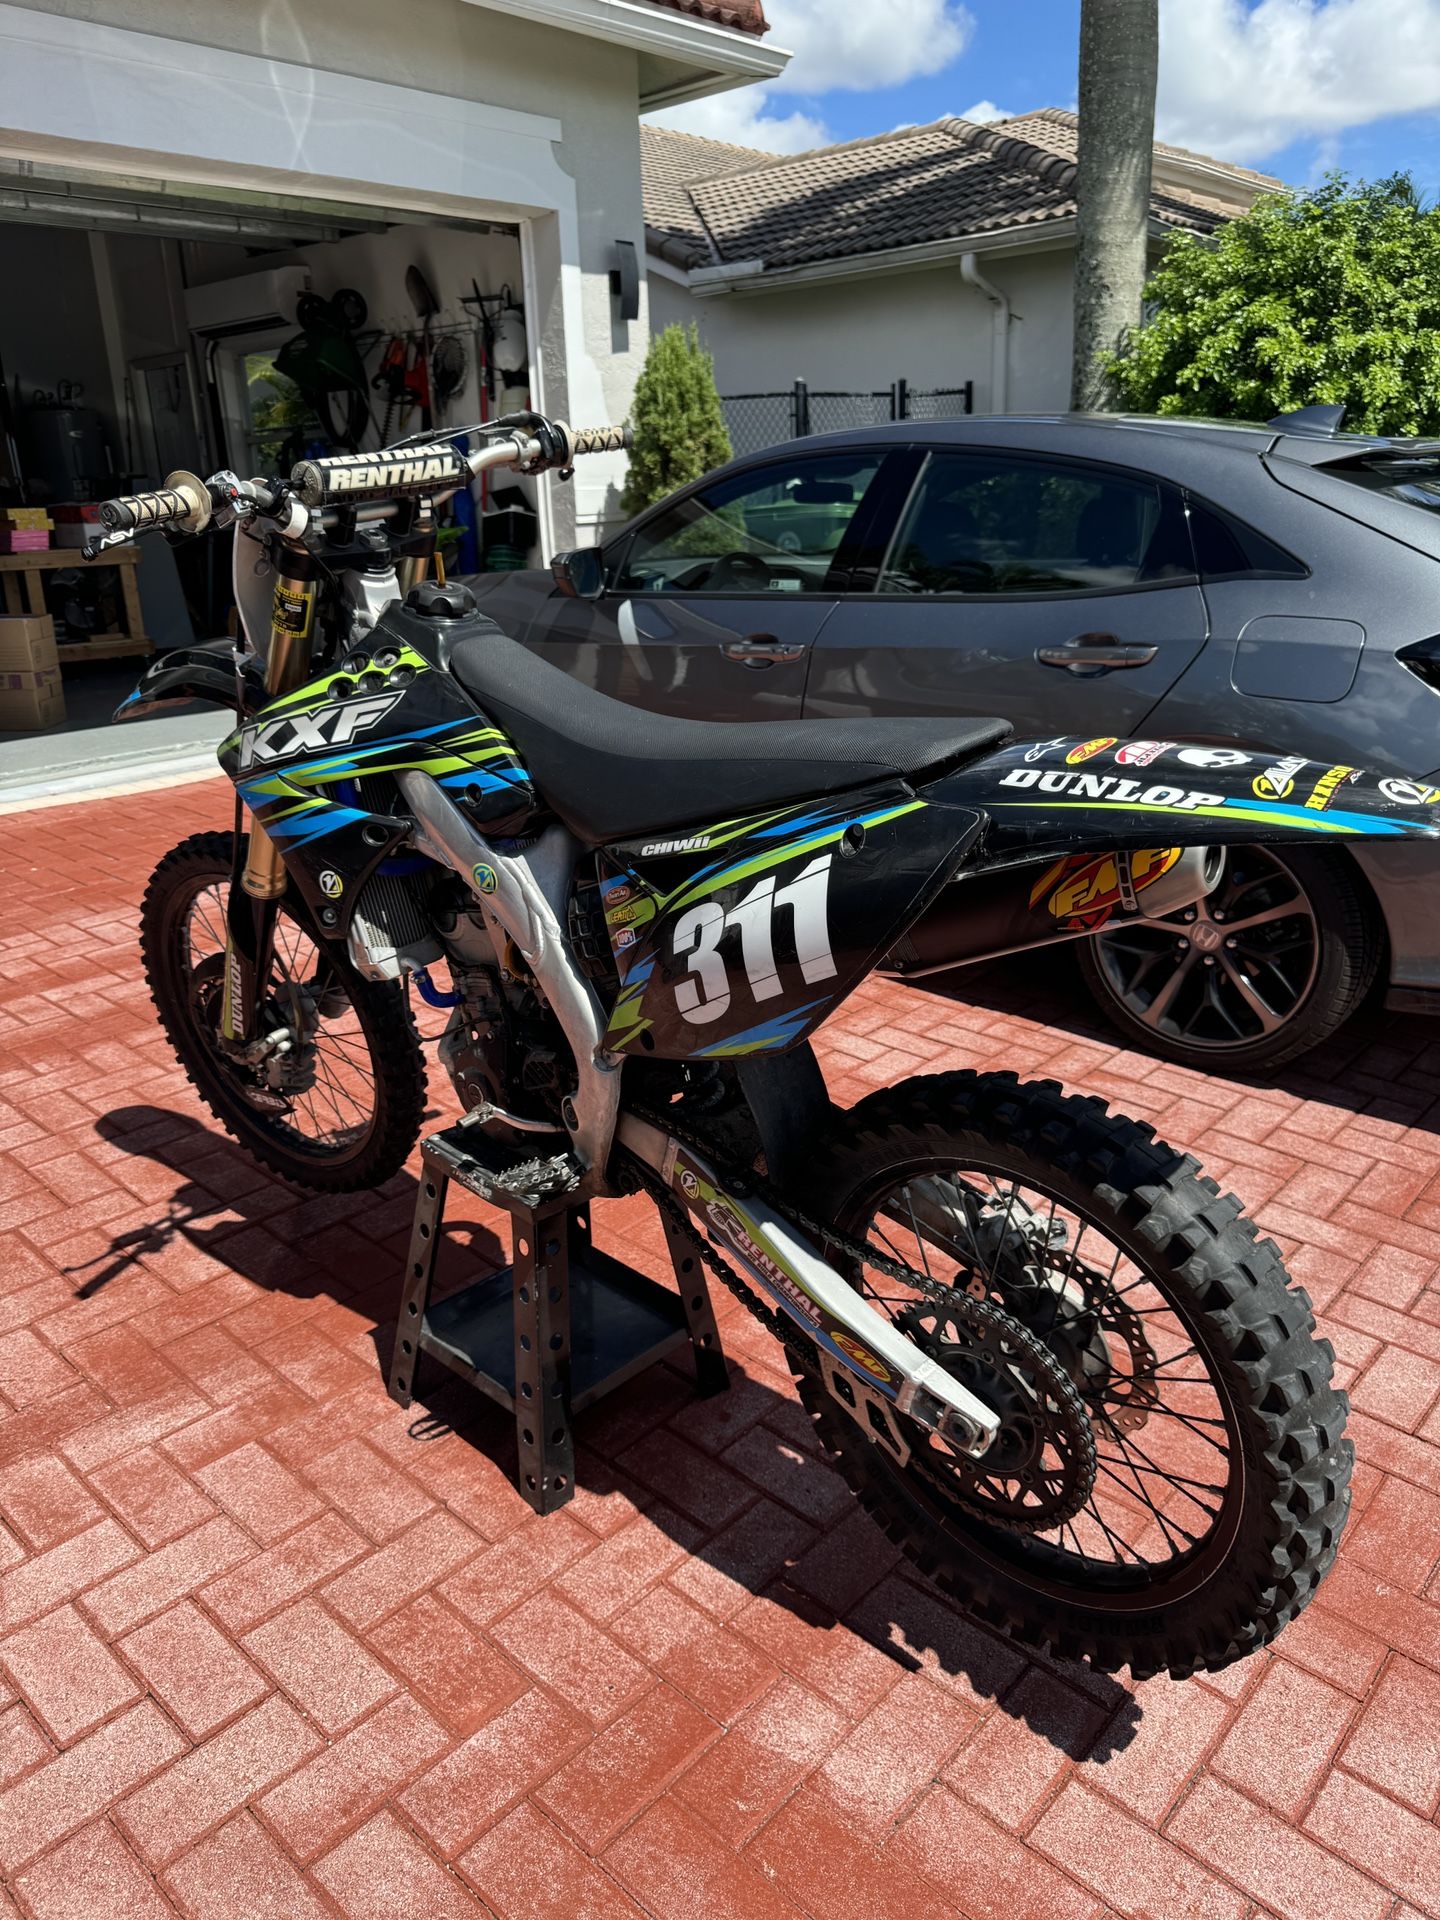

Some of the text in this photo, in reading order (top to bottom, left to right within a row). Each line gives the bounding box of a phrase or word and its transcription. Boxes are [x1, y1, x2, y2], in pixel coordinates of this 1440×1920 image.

[328, 456, 460, 491] RENTHAL
[100, 527, 134, 550] ASV
[238, 692, 403, 771] KXF
[1067, 738, 1112, 763] FMF
[998, 768, 1226, 811] DUNLOP
[1303, 764, 1355, 811] HINSO
[672, 852, 839, 1026] 311
[230, 952, 244, 1035] DUNLOP
[738, 1231, 822, 1323] RENTHAL
[831, 1334, 889, 1380] FMF
